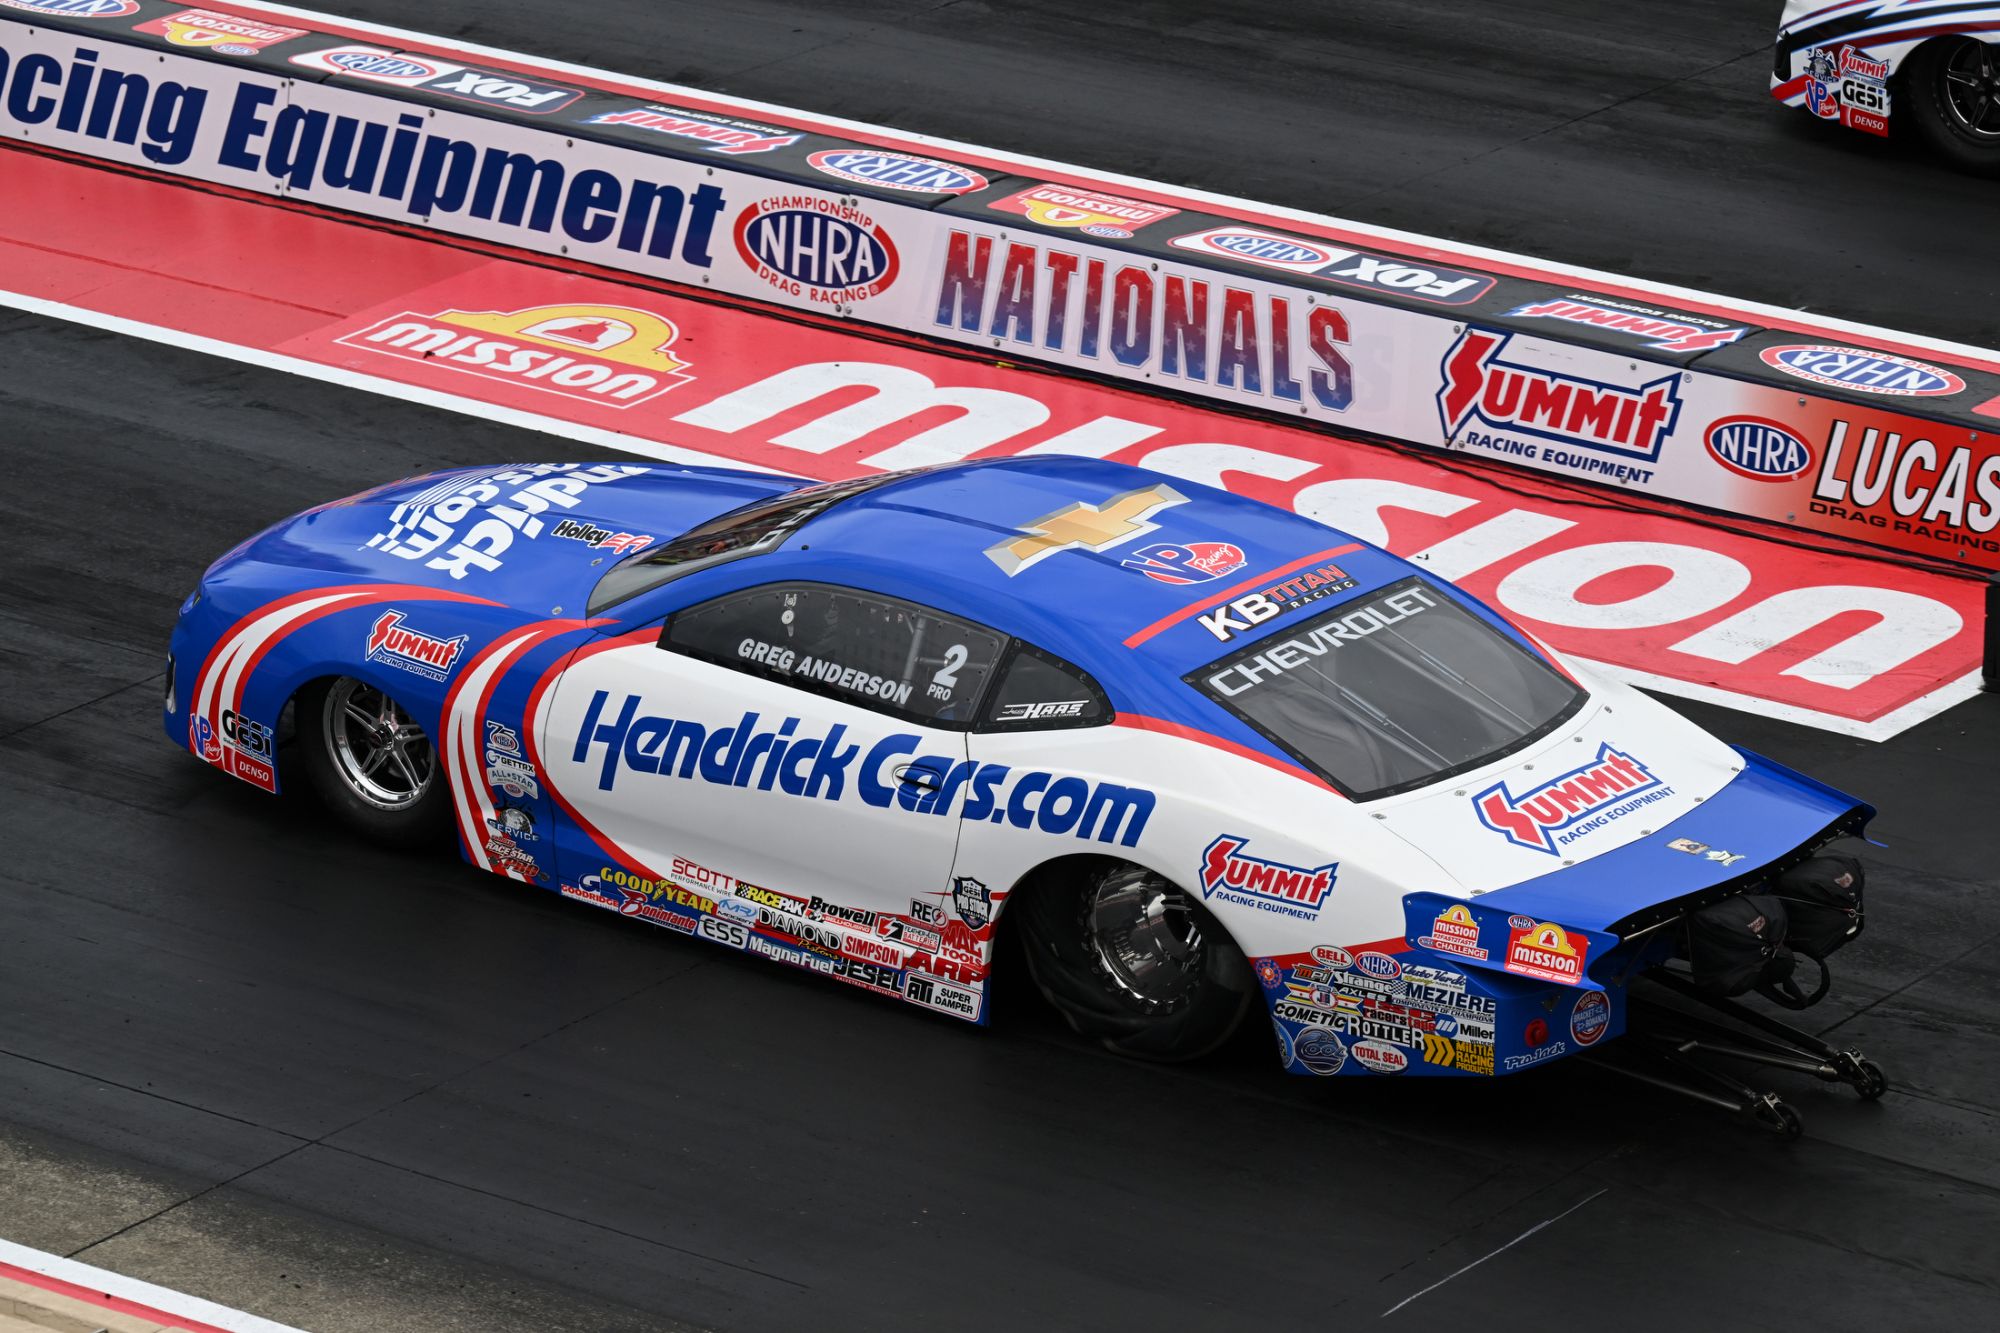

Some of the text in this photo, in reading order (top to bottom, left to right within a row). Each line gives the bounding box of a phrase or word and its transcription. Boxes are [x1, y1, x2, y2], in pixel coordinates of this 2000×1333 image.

[336, 53, 422, 77] NHRA
[434, 73, 568, 107] FOX
[1854, 114, 1884, 131] DENSO
[0, 46, 726, 268] cing Equipment
[834, 154, 963, 188] NHRA
[761, 195, 873, 228] CHAMPIONSHIP
[1031, 189, 1156, 222] mission
[759, 214, 876, 286] NHRA
[1212, 232, 1321, 264] NHRA
[758, 266, 868, 304] DRAG RACING
[1330, 257, 1480, 298] FOX
[932, 227, 1356, 413] NATIONALS
[365, 322, 658, 400] mission
[1790, 350, 1938, 390] NHRA
[1901, 359, 1950, 377] DRAG
[1465, 430, 1654, 484] RACING EQUIPMENT
[1720, 426, 1801, 472] NHRA
[1812, 418, 2000, 534] LUCAS
[552, 520, 609, 547] Holley
[1809, 501, 2000, 554] DRAG RACING
[1120, 543, 1217, 583] VP
[1193, 544, 1234, 572] Racing
[1289, 579, 1355, 609] RACING
[1208, 586, 1437, 698] CHEVROLET
[374, 654, 448, 683] RACING EQUIPMENT
[737, 638, 914, 705] GREG ANDERSON
[932, 644, 969, 688] 2
[926, 683, 952, 702] PRO
[1022, 703, 1084, 719] HAAS
[239, 760, 269, 782] DENSO
[491, 768, 507, 779] ALL
[511, 772, 533, 790] STAR
[1557, 786, 1676, 846] RACING EQUIPMENT
[670, 873, 732, 897] PERFORMANCE WIRE
[671, 858, 734, 889] SCOTT
[561, 884, 619, 907] GOODRIDGE
[808, 895, 877, 927] Browell
[1215, 891, 1319, 922] RACING EQUIPMENT
[703, 918, 744, 947] ESS
[758, 906, 842, 950] DIAMOND
[903, 931, 938, 946] BATTERIES
[1436, 920, 1478, 939] mission
[748, 935, 835, 976] MagnaFuel
[845, 935, 900, 967] SIMPSON
[941, 947, 983, 968] TOOLS
[1316, 947, 1348, 964] BELL
[1362, 957, 1394, 975] NHRA
[1435, 941, 1486, 960] CHALLENGE
[1514, 946, 1576, 974] mission
[833, 958, 905, 993] JESEL
[905, 950, 988, 986] ARP
[935, 995, 974, 1015] DAMPER
[940, 987, 971, 1004] SUPER
[1407, 981, 1496, 1014] MEZIERE
[1274, 1002, 1347, 1029] COMETIC
[1347, 1015, 1425, 1051] ROTTLER
[1460, 1023, 1495, 1040] Miller
[1354, 1045, 1381, 1061] TOTAL
[1382, 1051, 1405, 1067] SEAL
[1455, 1052, 1495, 1068] RACING
[1455, 1061, 1495, 1077] PRODUCTS
